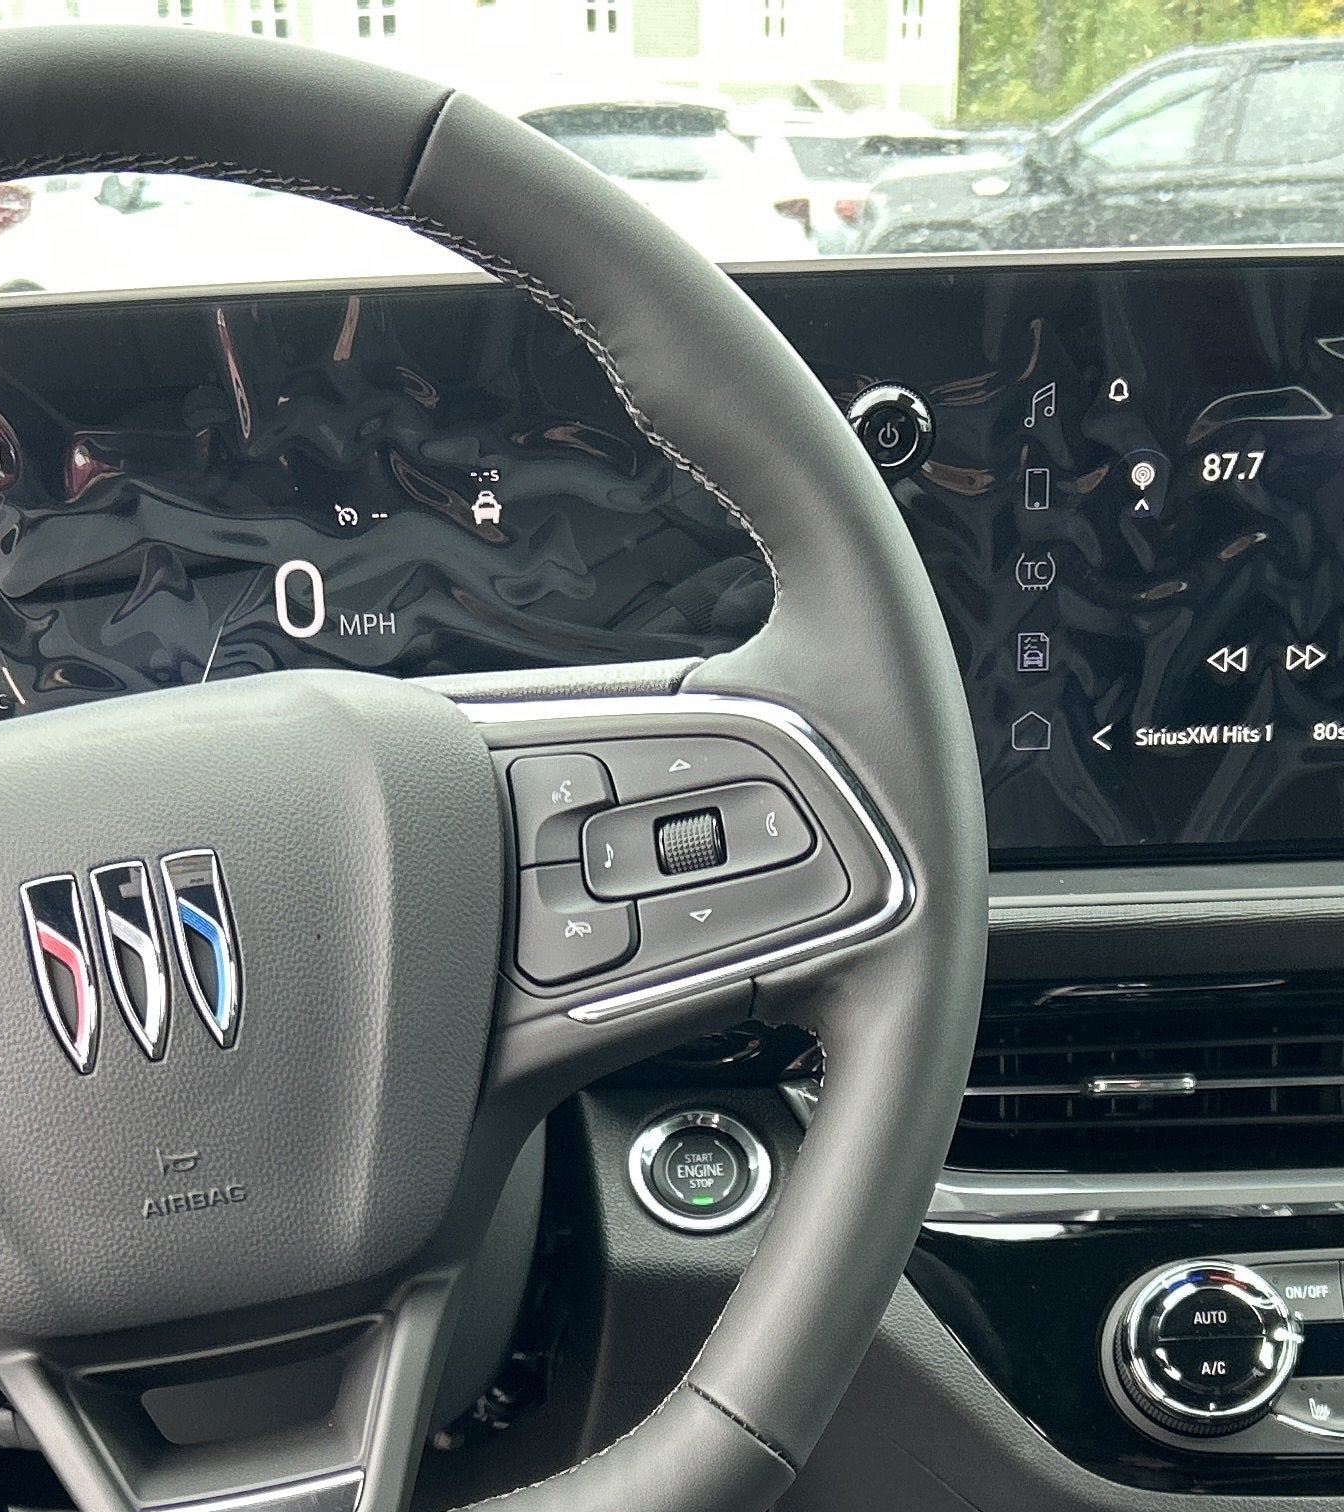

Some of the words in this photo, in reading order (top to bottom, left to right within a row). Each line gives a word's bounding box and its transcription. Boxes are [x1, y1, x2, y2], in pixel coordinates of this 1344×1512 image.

[1202, 450, 1265, 481] 87.7
[1022, 561, 1048, 580] TC
[275, 560, 325, 638] 0
[340, 612, 396, 636] MPH
[1135, 725, 1218, 746] SiriusXM
[1222, 725, 1260, 744] Hits
[1264, 724, 1273, 742] 1
[684, 1152, 713, 1163] START
[677, 1162, 724, 1178] ENGINE
[689, 1178, 714, 1189] STOP
[143, 1184, 248, 1219] AIRBAG
[1285, 1284, 1329, 1299] ON/OFF
[1193, 1310, 1227, 1325] AUTO
[1201, 1361, 1226, 1375] A/C
